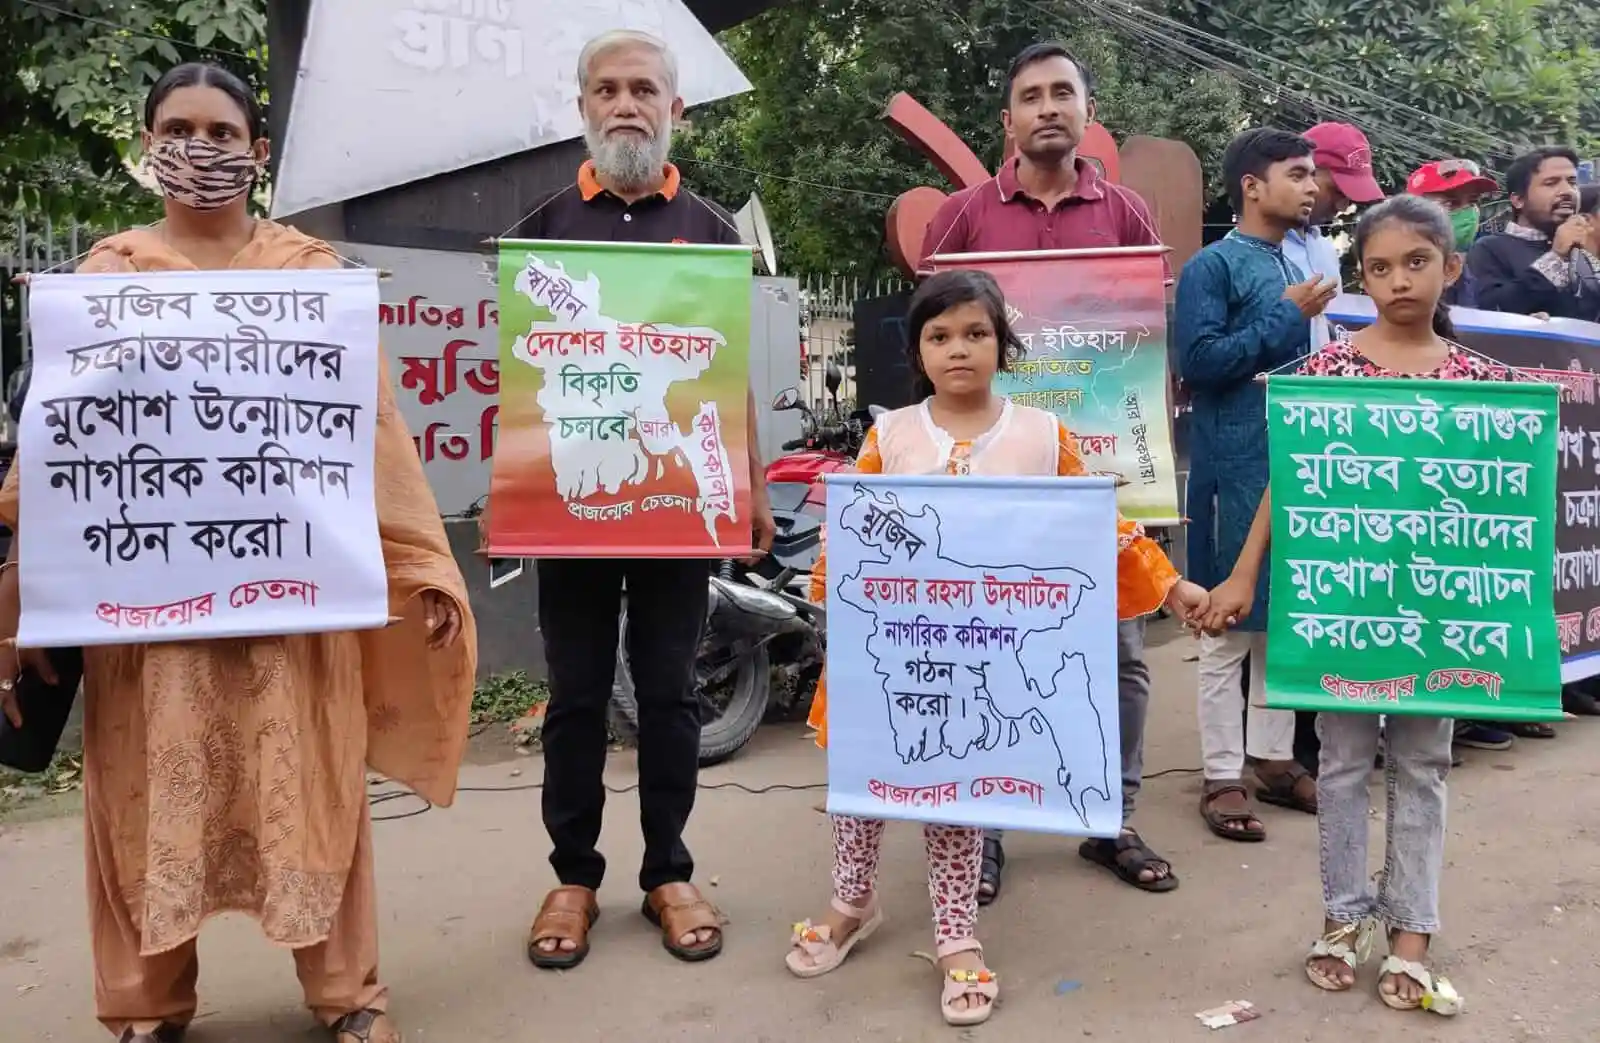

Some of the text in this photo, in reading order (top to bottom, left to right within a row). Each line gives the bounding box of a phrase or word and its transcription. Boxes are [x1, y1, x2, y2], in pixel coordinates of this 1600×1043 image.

[84, 285, 329, 330] মুজিব হত্যার
[526, 265, 587, 321] স্বাধীন
[66, 325, 347, 382] চক্রান্তকারীদের
[526, 322, 716, 362] দেশের ইতিহাস
[1041, 324, 1128, 352] ইতিহাস
[558, 362, 642, 408] বিকৃতি
[42, 381, 362, 449] মুখোশ উন্মোচনে
[557, 414, 674, 442] চলবে আর
[1279, 394, 1547, 444] সময় যতই লাগুক
[46, 441, 355, 503] নাগরিক কমিশন
[1290, 442, 1534, 497] মুজিব হত্যার
[567, 494, 693, 522] প্রজন্মের চেতনা
[864, 505, 927, 561] মুজিব
[1283, 499, 1538, 550] চক্রান্তকারীদের
[84, 504, 176, 565] গঠন
[96, 579, 319, 629] প্রজন্মের চেতনা
[862, 576, 919, 606] হত্যার
[925, 579, 976, 609] রহস্য
[1286, 551, 1536, 607] মুখোশ উন্মোচন
[884, 615, 1017, 650] নাগরিক কমিশন
[1288, 604, 1429, 657] করতেই
[905, 651, 956, 685] গঠন
[1320, 668, 1504, 704] প্রজন্মের চেতনা
[868, 775, 1045, 807] প্রজন্মের চেতনা
